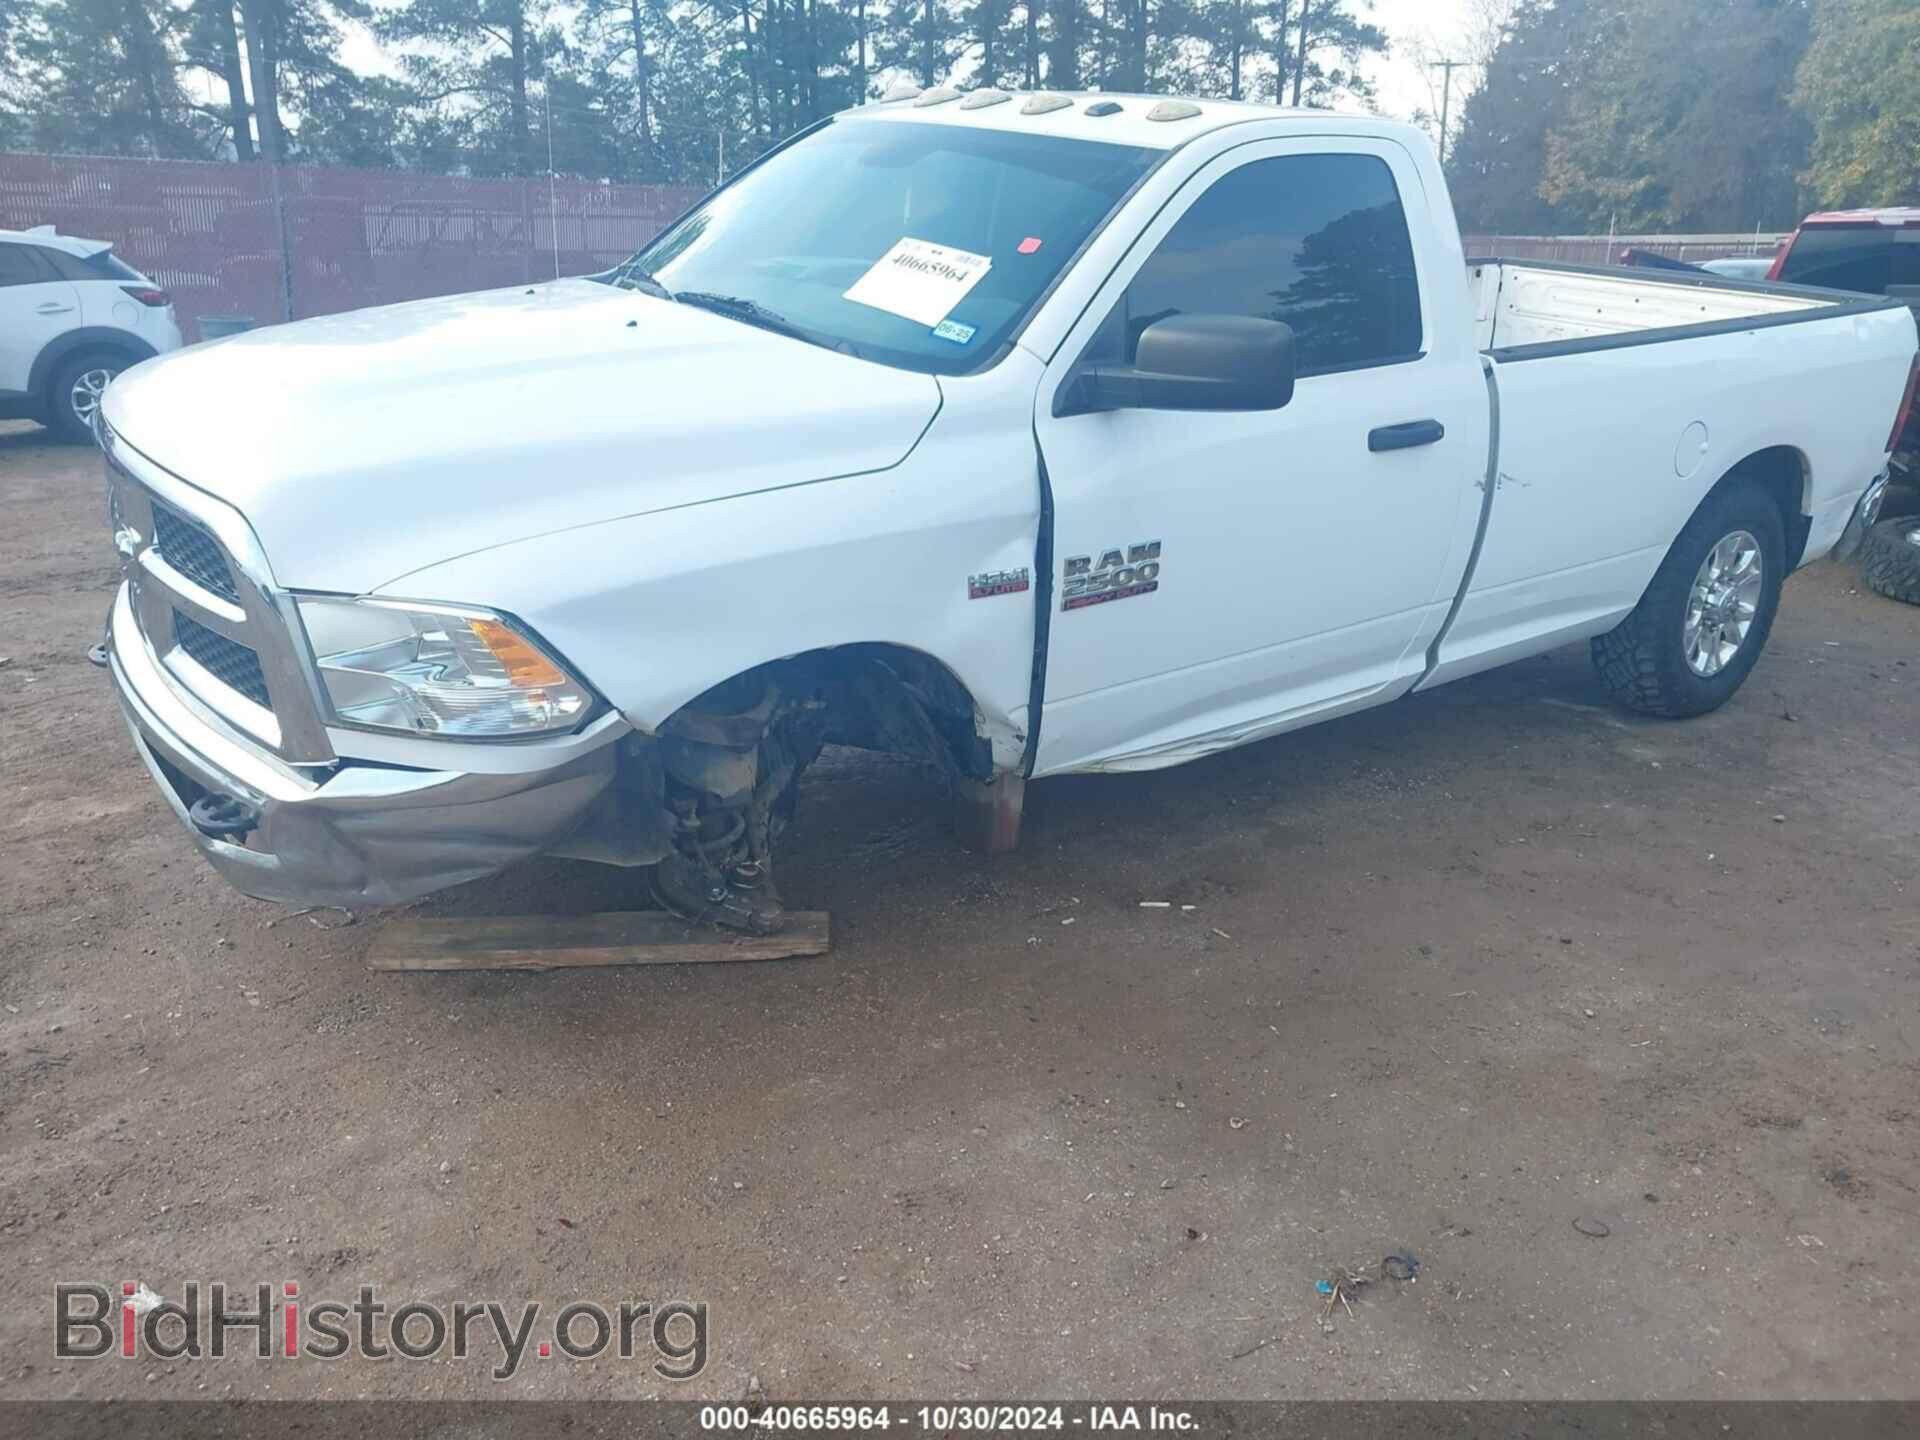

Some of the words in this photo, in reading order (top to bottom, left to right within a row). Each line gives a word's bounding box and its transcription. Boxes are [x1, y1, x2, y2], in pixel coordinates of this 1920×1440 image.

[892, 253, 969, 282] 40665964
[1063, 539, 1162, 576] RAM
[1063, 560, 1161, 597] 2500
